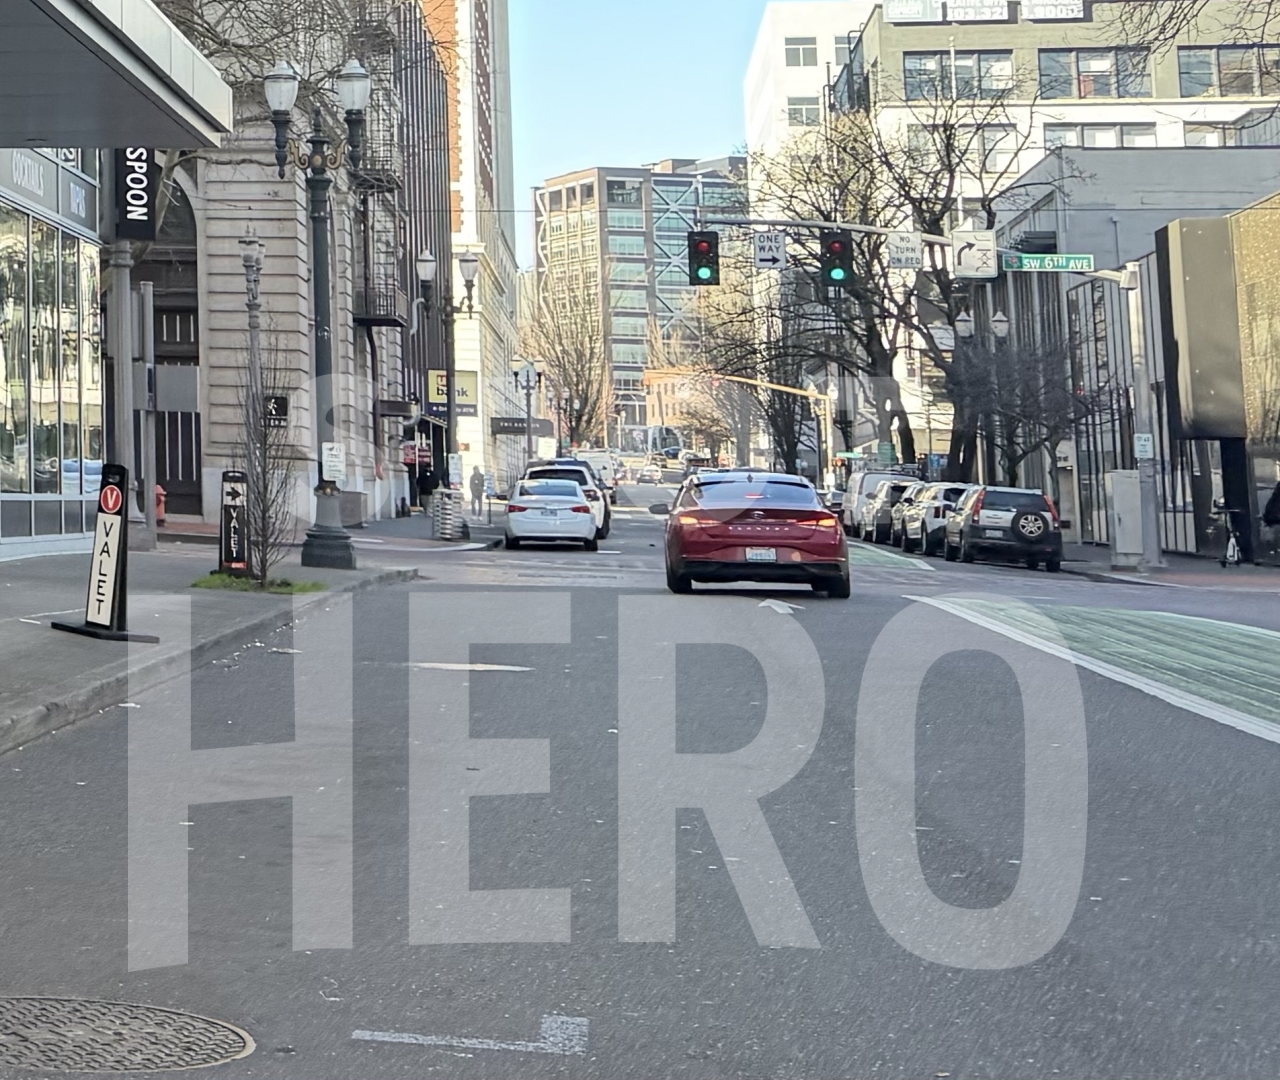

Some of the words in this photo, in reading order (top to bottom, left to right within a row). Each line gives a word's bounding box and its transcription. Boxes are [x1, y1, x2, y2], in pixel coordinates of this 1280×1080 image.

[126, 147, 148, 220] SPOON
[758, 234, 780, 243] ONE
[757, 245, 781, 253] WAY
[895, 246, 916, 254] TURN
[1023, 258, 1040, 269] SW
[1044, 256, 1067, 269] 6TH
[1068, 259, 1090, 270] AVE
[230, 508, 239, 558] VALET
[96, 521, 114, 615] VALET
